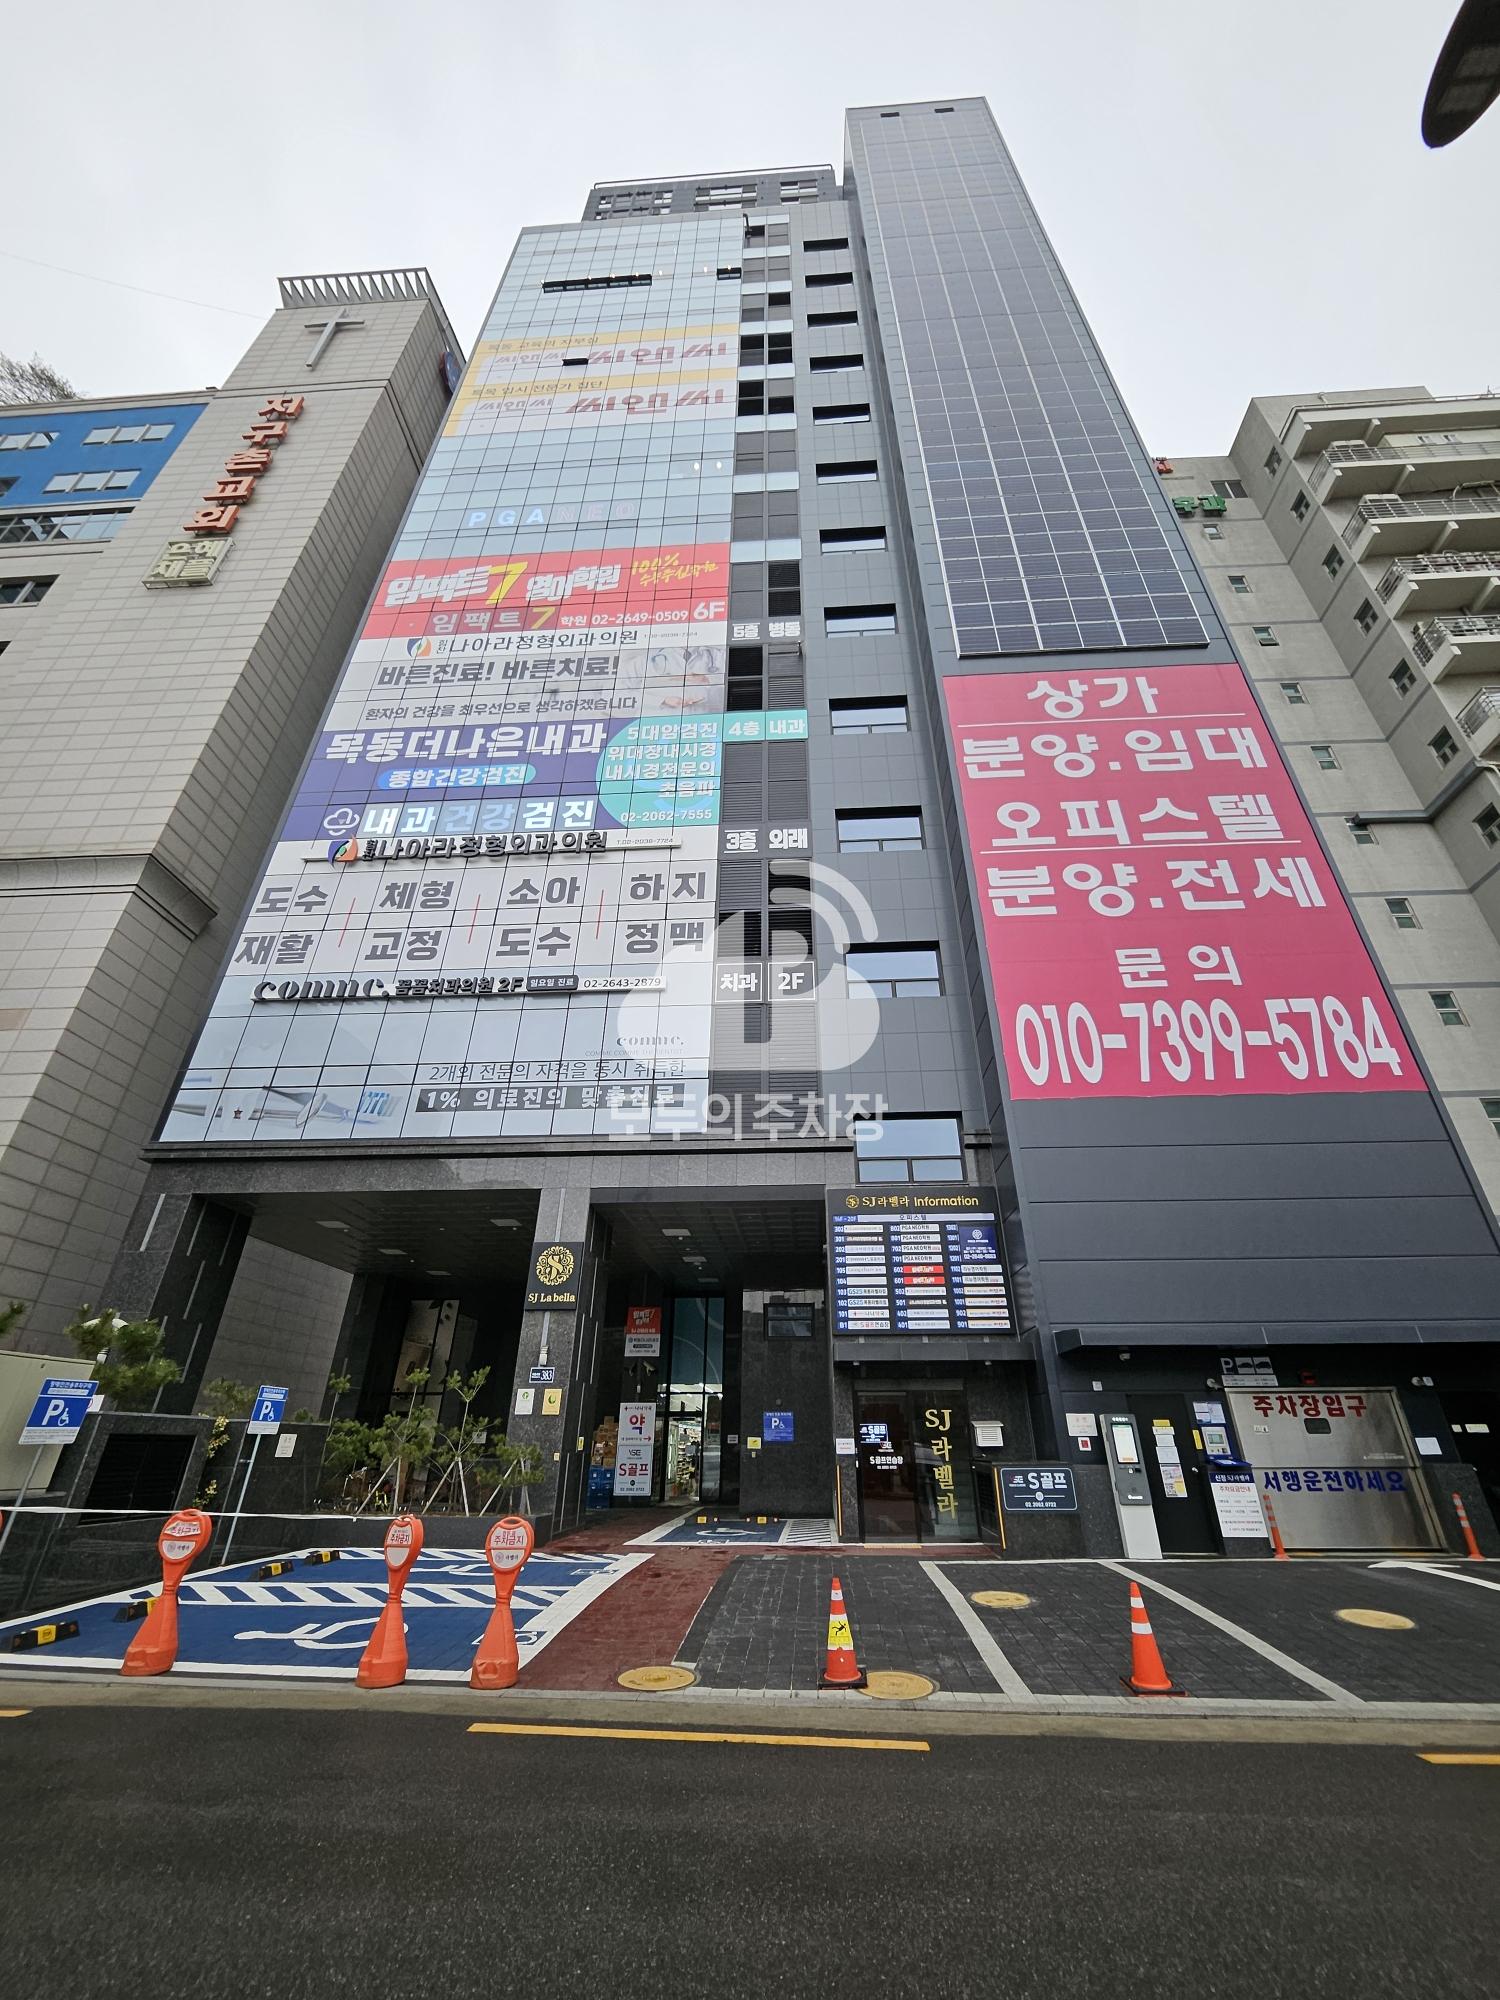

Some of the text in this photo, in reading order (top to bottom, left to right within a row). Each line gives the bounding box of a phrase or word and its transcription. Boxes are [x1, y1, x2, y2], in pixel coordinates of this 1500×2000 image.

[467, 507, 545, 527] PGA
[631, 553, 680, 575] 100%
[561, 615, 587, 627] 학원
[591, 610, 688, 625] 02-2649-0509
[693, 601, 726, 620] 6F
[769, 621, 801, 638] 병동
[377, 656, 619, 686] 바른진료! 바른치료!
[365, 697, 637, 721] 환자의 건강을 최우선으로 생각하겠습니다
[1026, 676, 1159, 720] 상가
[628, 721, 718, 740] 5대암검진
[728, 719, 806, 736] 4층 내과
[326, 722, 607, 764] 목동더나은내과
[608, 742, 716, 761] 위대장내시경
[962, 726, 1268, 780] 분양.임대
[388, 765, 525, 789] 종합건강검진
[605, 761, 715, 780] 내시경전문의
[620, 809, 712, 823] 02-2062-7555
[991, 793, 1284, 847] 오피스텔
[726, 828, 808, 850] 3층 외래
[255, 871, 706, 913] 도수 체형 소아 하지
[987, 856, 1327, 918] 분양.전세
[234, 921, 704, 965] 재활 교정 도수 정맥
[497, 976, 524, 993] 2F
[530, 978, 553, 988] 일요일
[583, 977, 661, 989] 02-2643-2879
[720, 972, 805, 992] 치과 2F
[1015, 995, 1404, 1086] 010-7399-5784
[429, 1063, 474, 1082] 2개의
[479, 1062, 531, 1081] 전문의
[535, 1061, 587, 1080] 자격을
[593, 1060, 627, 1079] 동시
[426, 1090, 461, 1109] 1%
[473, 1086, 568, 1110] 의료진의
[913, 1195, 979, 1207] Information
[528, 1293, 538, 1303] SJ
[553, 1292, 576, 1303] bella
[1220, 1357, 1234, 1374] P
[41, 1399, 65, 1426] P
[259, 1400, 272, 1421] P
[1252, 1394, 1367, 1418] 주차장입구
[629, 1412, 646, 1435] 약
[771, 1417, 780, 1429] P
[867, 1425, 886, 1435] S골프
[618, 1463, 649, 1477] S골프
[925, 1408, 959, 1520] SJ 라벨라
[1027, 1472, 1068, 1490] S골프
[1263, 1470, 1408, 1493] 서행운전하세요
[390, 1533, 410, 1544] 주차금지
[494, 1534, 524, 1546] 주차금지
